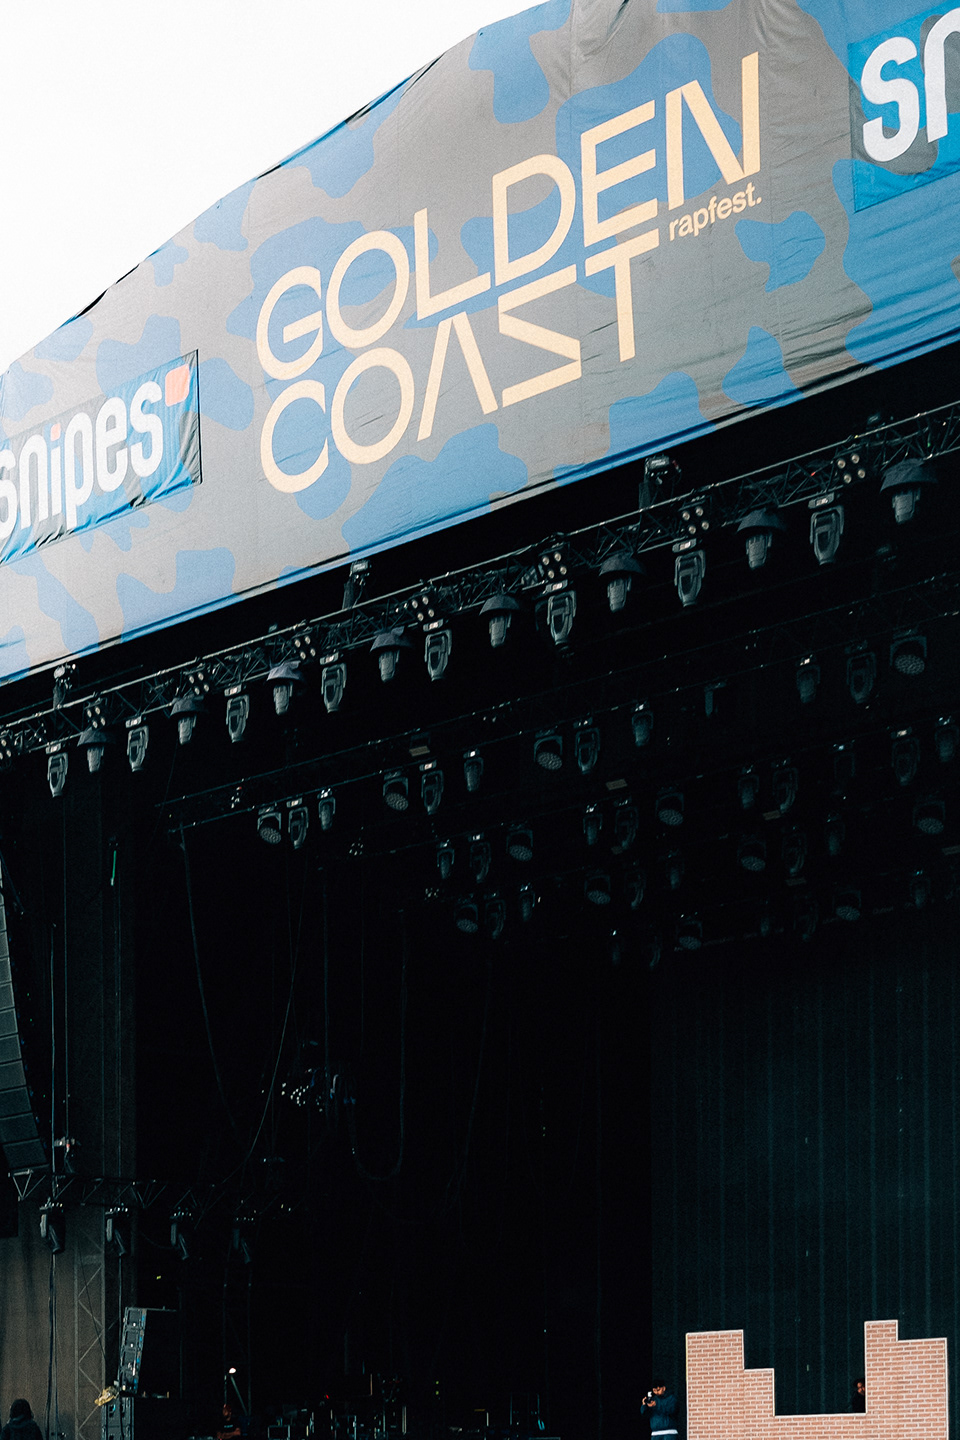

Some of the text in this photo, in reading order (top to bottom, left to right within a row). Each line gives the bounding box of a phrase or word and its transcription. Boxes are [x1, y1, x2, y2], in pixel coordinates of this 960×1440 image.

[256, 51, 760, 381] GOLDEN
[668, 183, 762, 241] rapfest.
[260, 229, 660, 494] COAST
